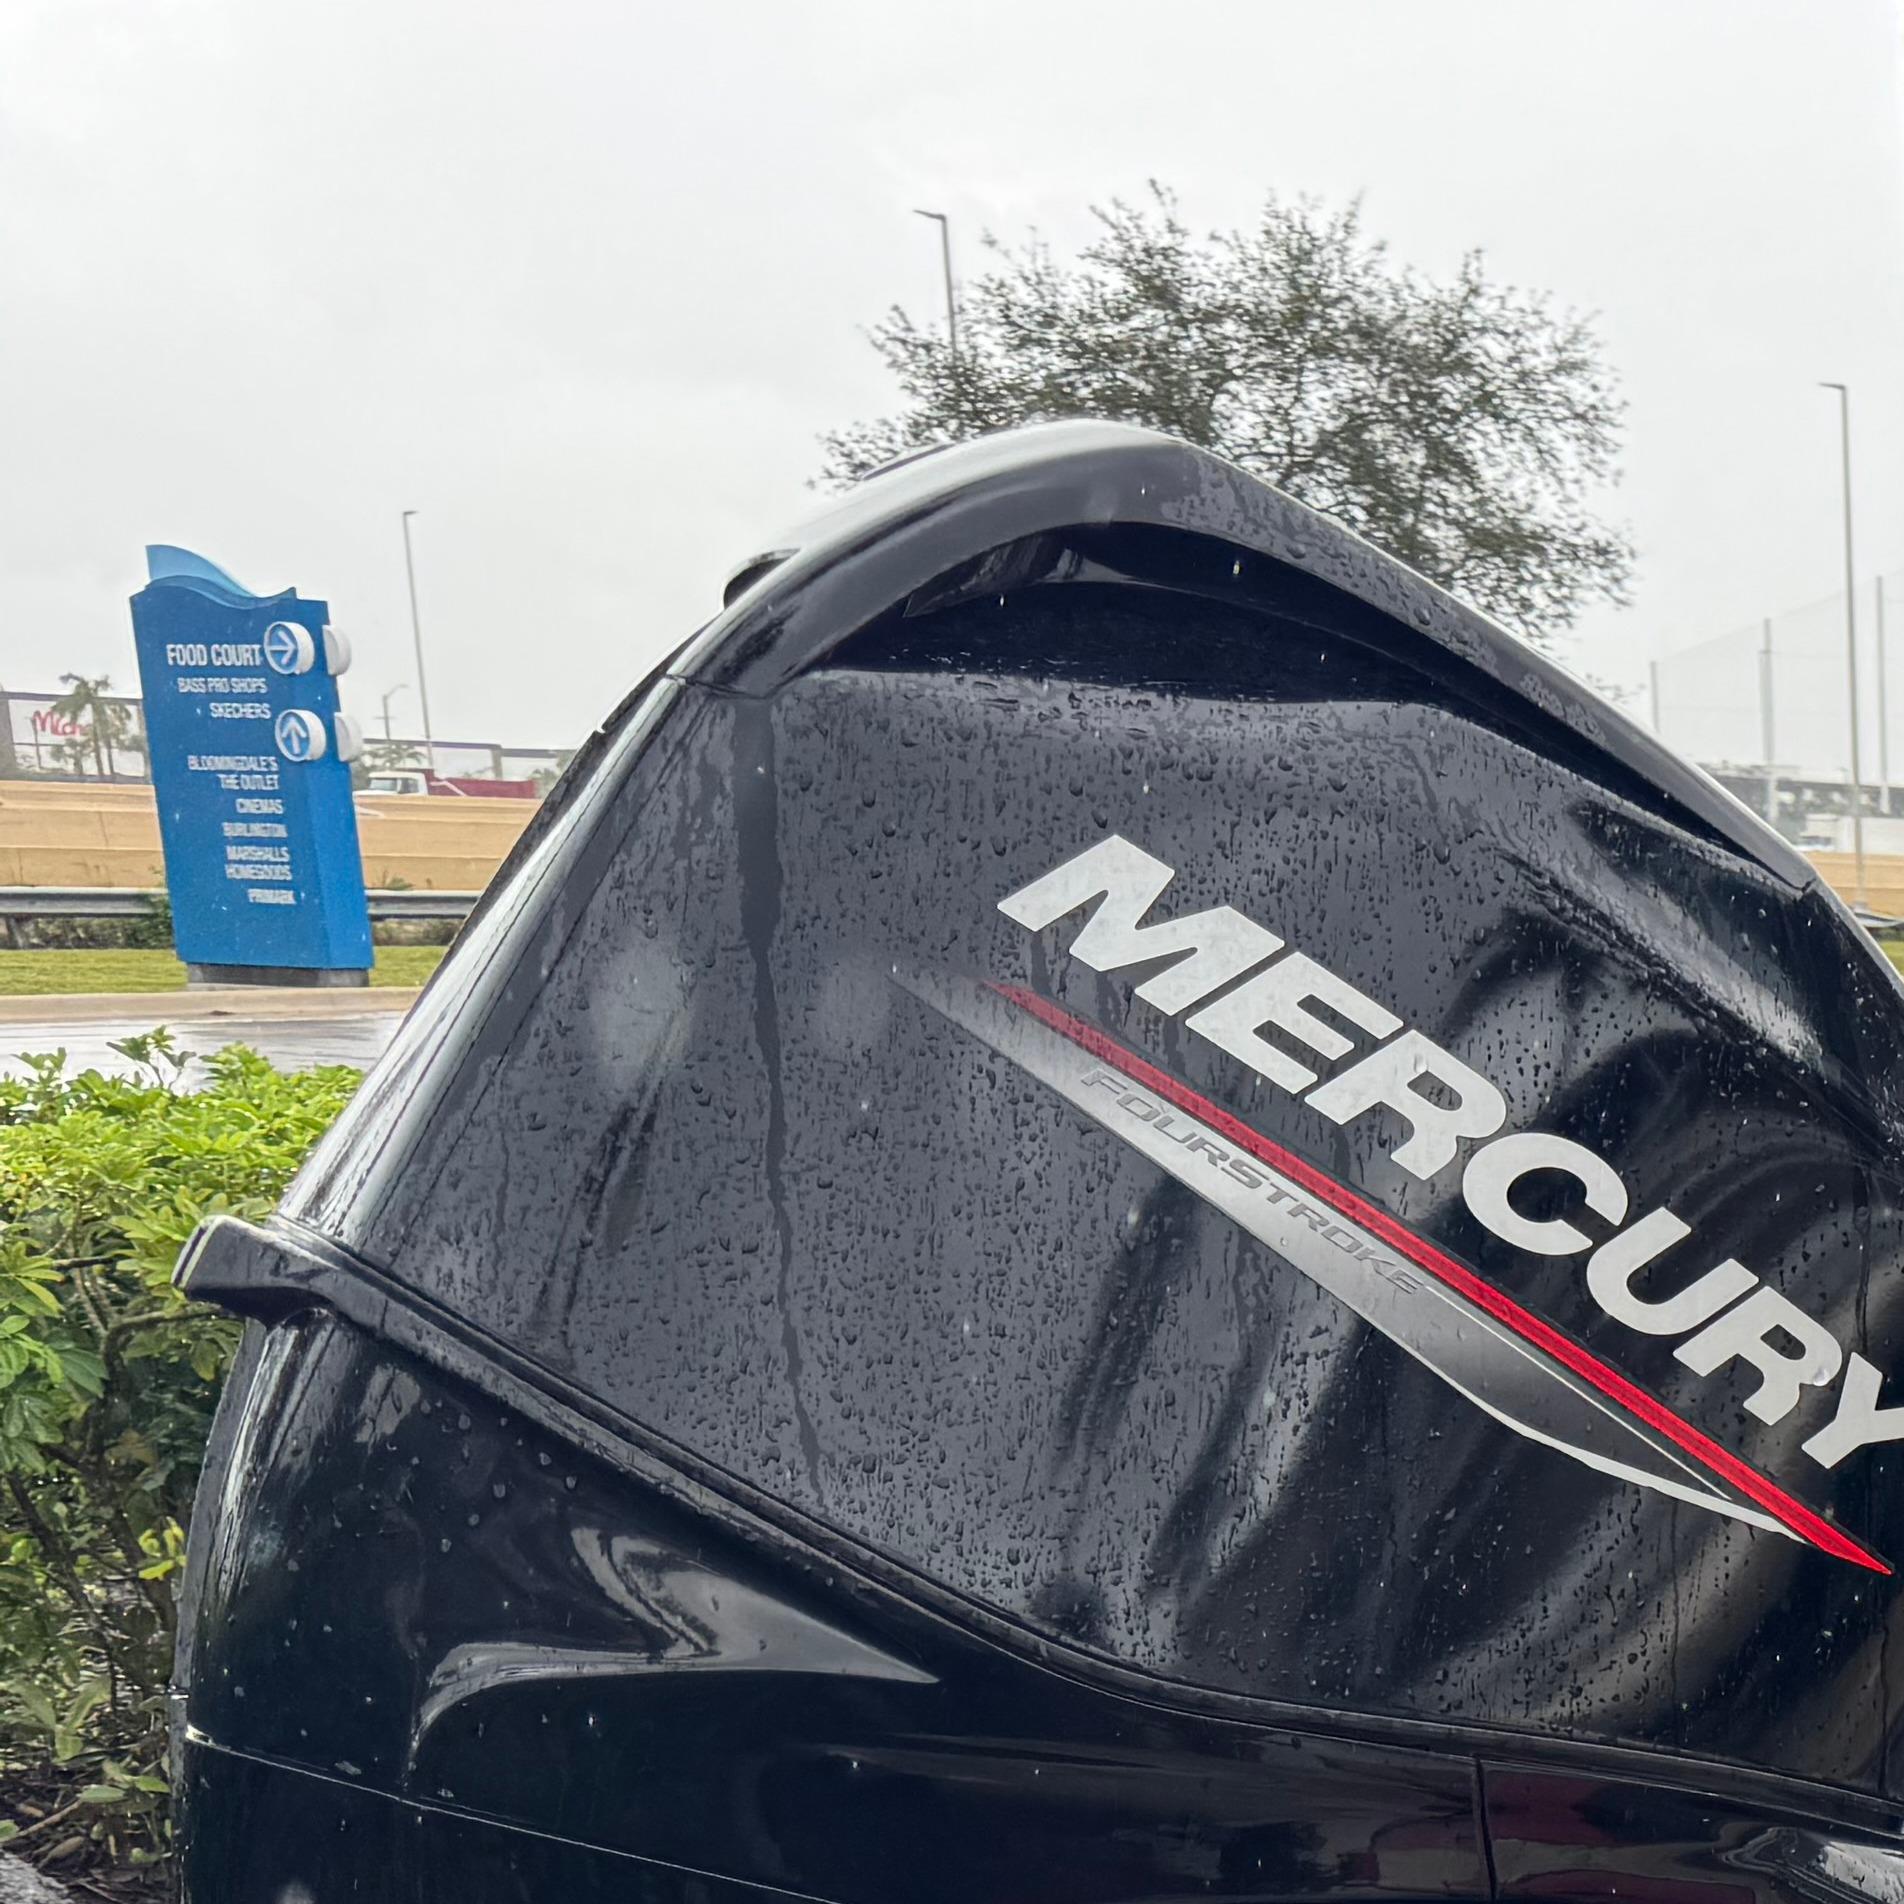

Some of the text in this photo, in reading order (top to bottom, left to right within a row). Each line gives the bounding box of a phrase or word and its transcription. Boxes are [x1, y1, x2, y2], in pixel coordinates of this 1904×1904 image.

[166, 644, 261, 666] FOOD COURT
[177, 677, 268, 693] BASS PRO SHOPS
[209, 702, 271, 719] SKECHERS
[217, 774, 279, 790] THE OUTLET
[236, 798, 283, 814] CINEMAS
[1080, 1066, 1425, 1295] FOURSTROKE
